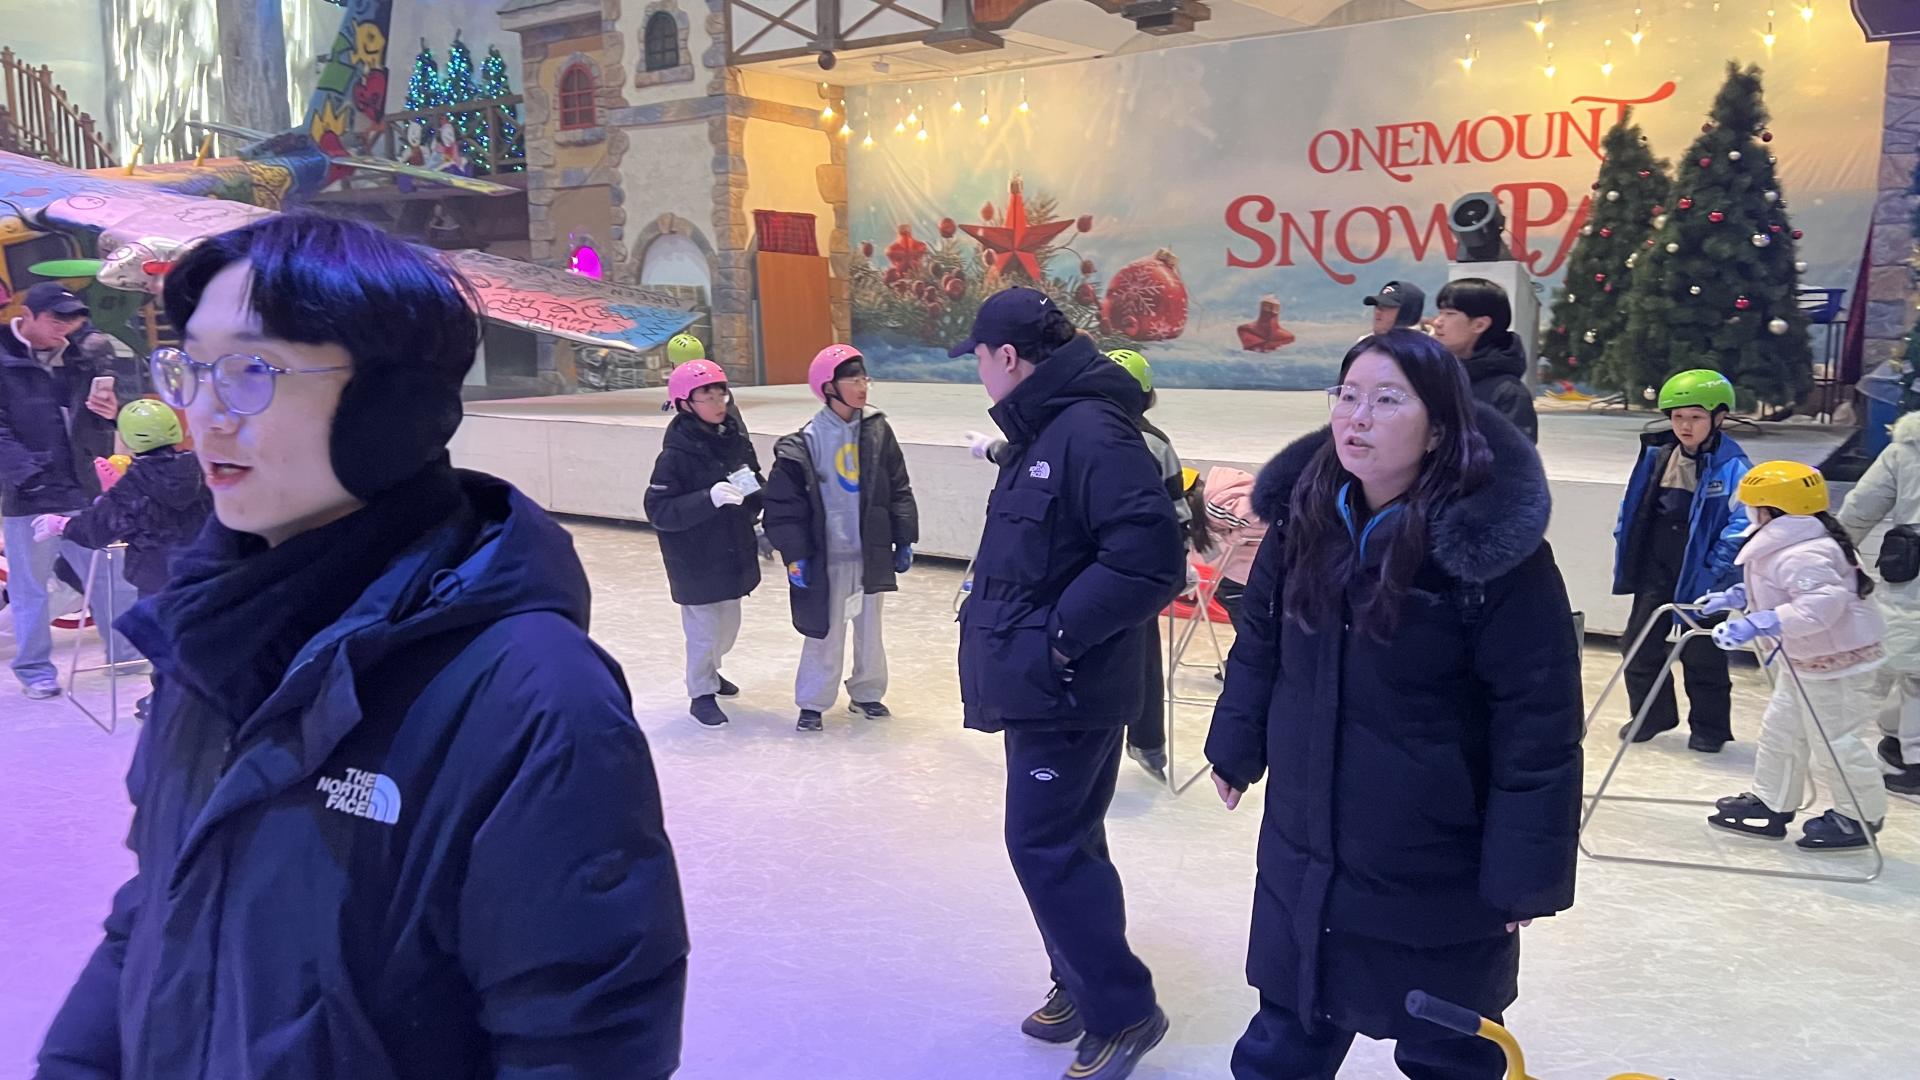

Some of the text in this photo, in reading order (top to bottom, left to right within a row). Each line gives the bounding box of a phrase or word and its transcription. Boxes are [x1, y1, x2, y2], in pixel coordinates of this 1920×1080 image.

[1308, 82, 1676, 182] ONEMOUNT
[1224, 194, 1459, 285] SNOW
[546, 313, 602, 329] HAPPY
[315, 776, 372, 802] NORTH
[345, 767, 377, 788] THE
[325, 794, 369, 817] FACE
